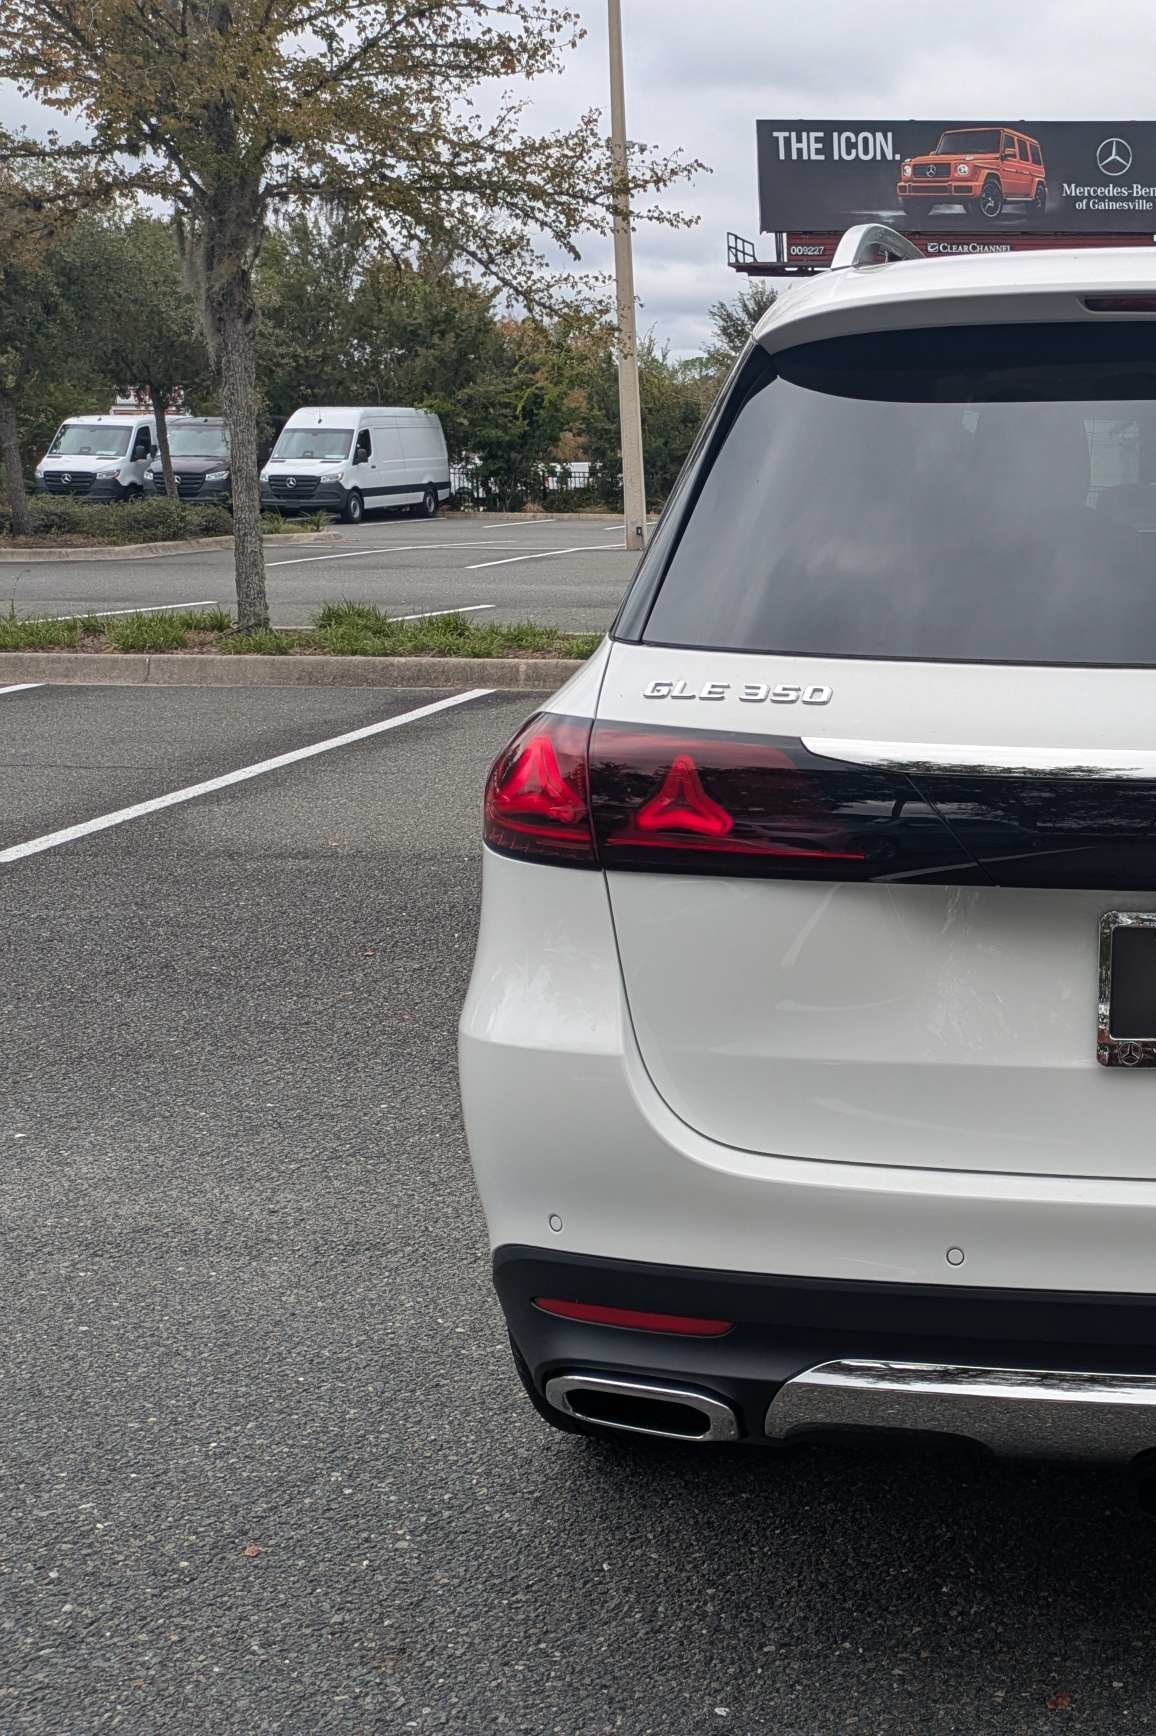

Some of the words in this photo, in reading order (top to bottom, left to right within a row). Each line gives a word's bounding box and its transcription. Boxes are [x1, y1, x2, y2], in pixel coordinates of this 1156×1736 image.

[772, 131, 825, 160] THE
[832, 131, 901, 160] ICON.
[1075, 199, 1087, 210] of
[1089, 199, 1153, 210] Gainesville
[643, 680, 731, 701] GLE
[738, 683, 834, 706] 350
